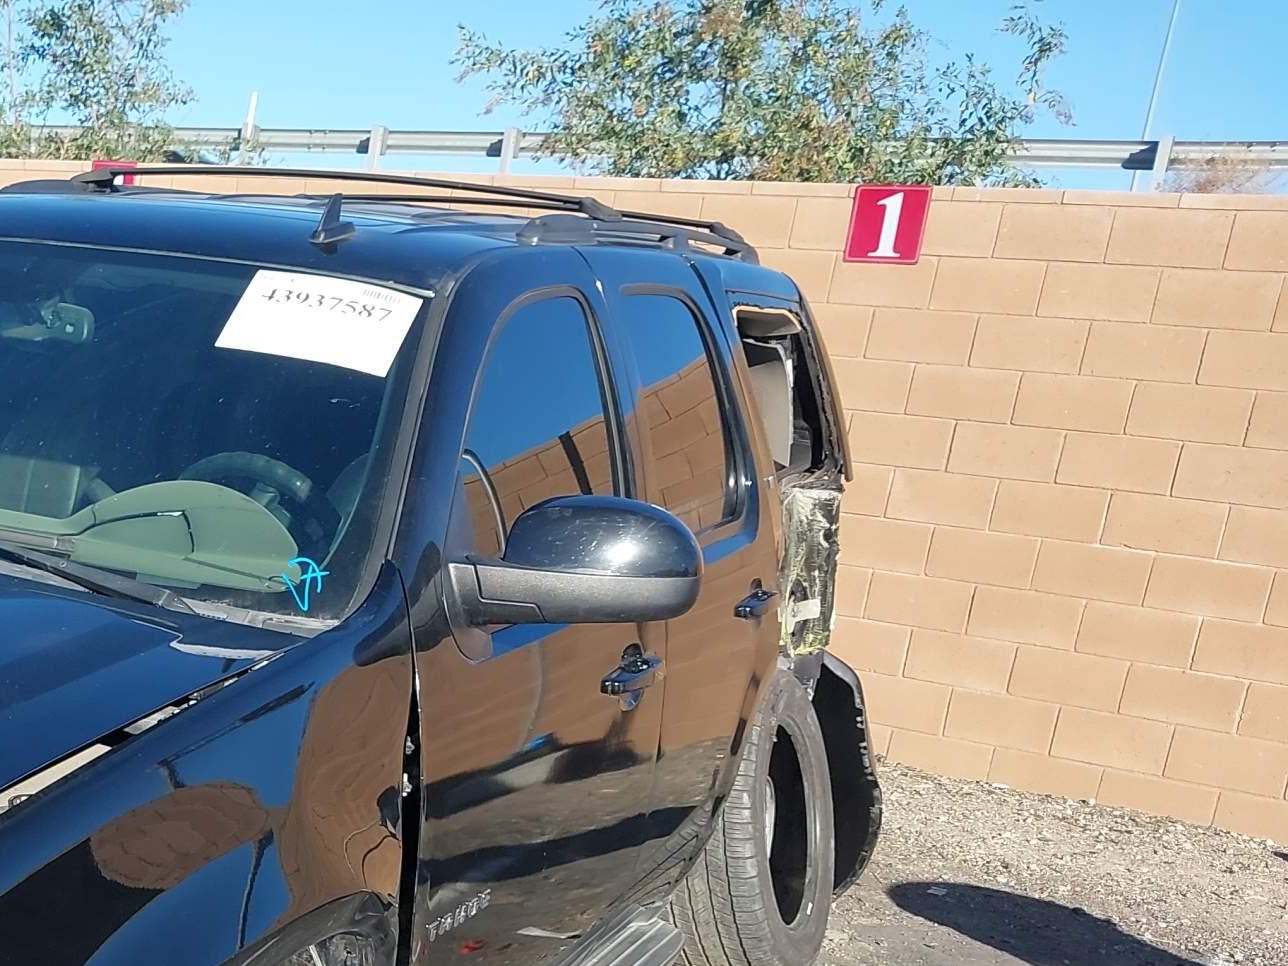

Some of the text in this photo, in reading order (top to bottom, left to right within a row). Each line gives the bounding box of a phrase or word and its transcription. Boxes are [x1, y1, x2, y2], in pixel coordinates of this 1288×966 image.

[866, 191, 905, 258] 1
[262, 288, 393, 322] 43937587
[425, 888, 492, 942] TAHOE
